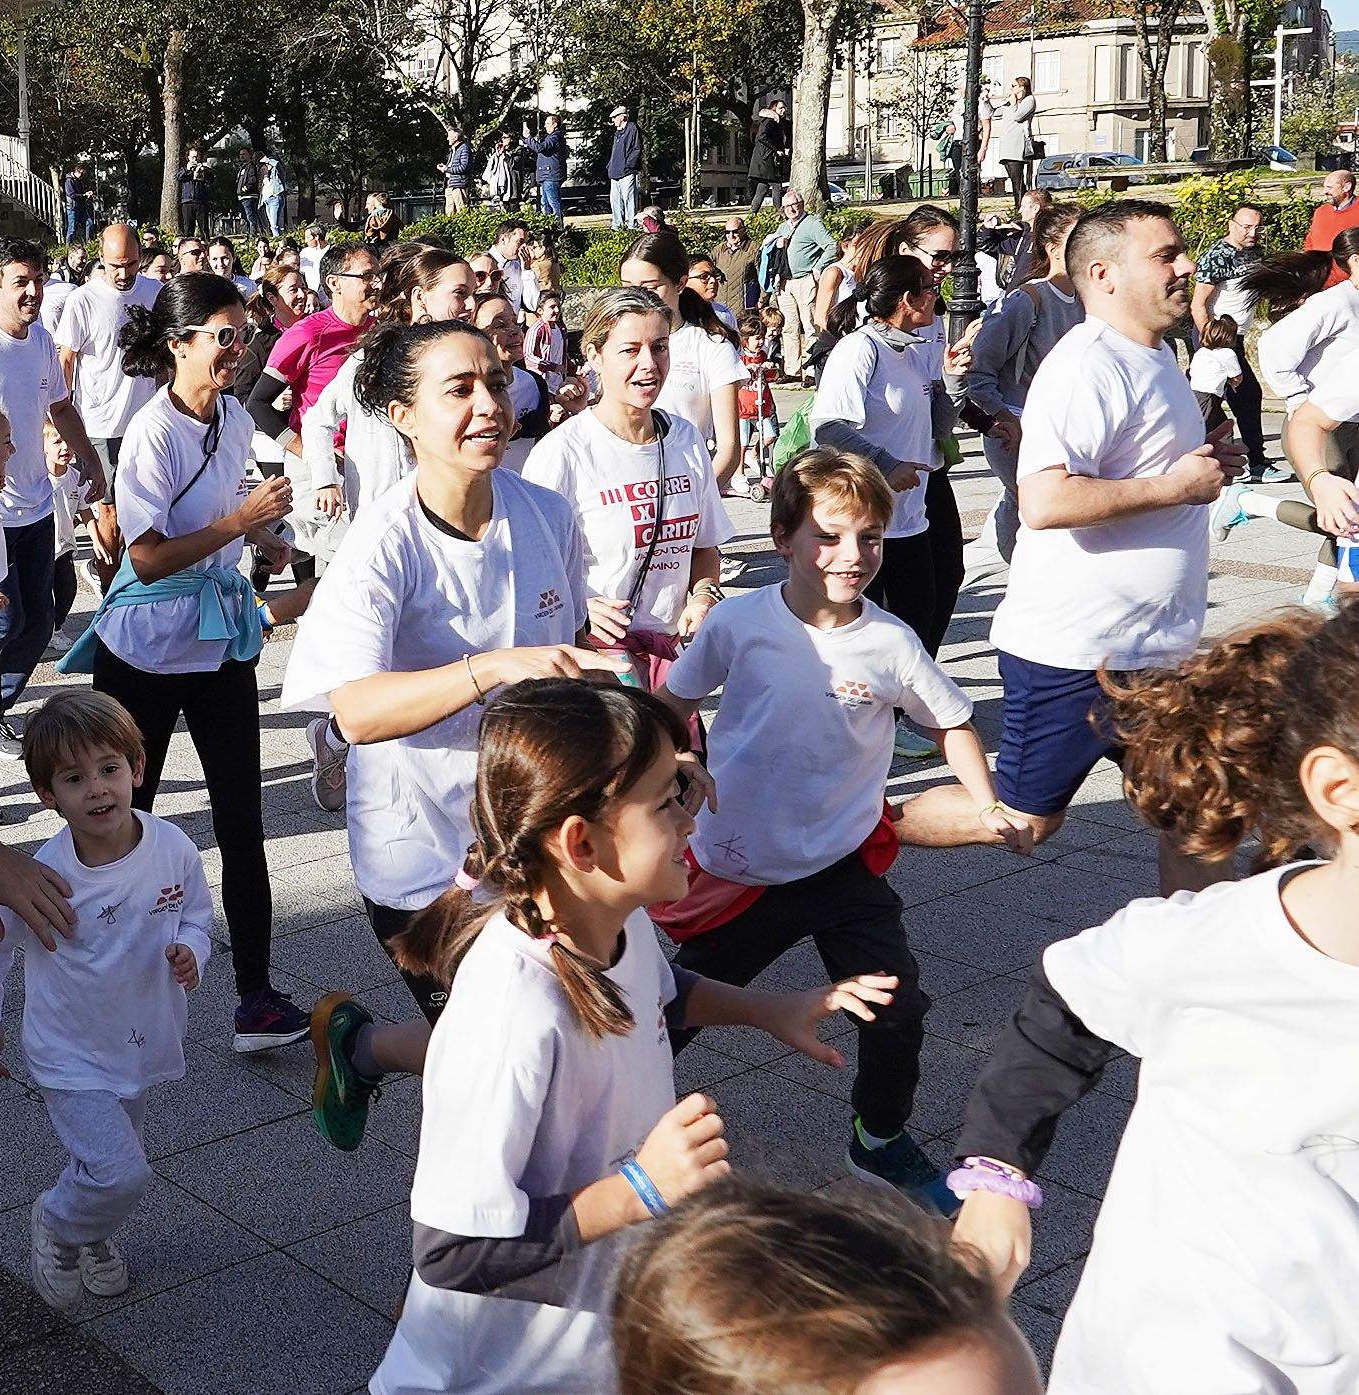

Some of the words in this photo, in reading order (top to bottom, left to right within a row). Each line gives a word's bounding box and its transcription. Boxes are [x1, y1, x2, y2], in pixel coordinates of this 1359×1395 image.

[632, 476, 691, 499] CORRE
[637, 506, 653, 522] X
[670, 545, 690, 555] DEL
